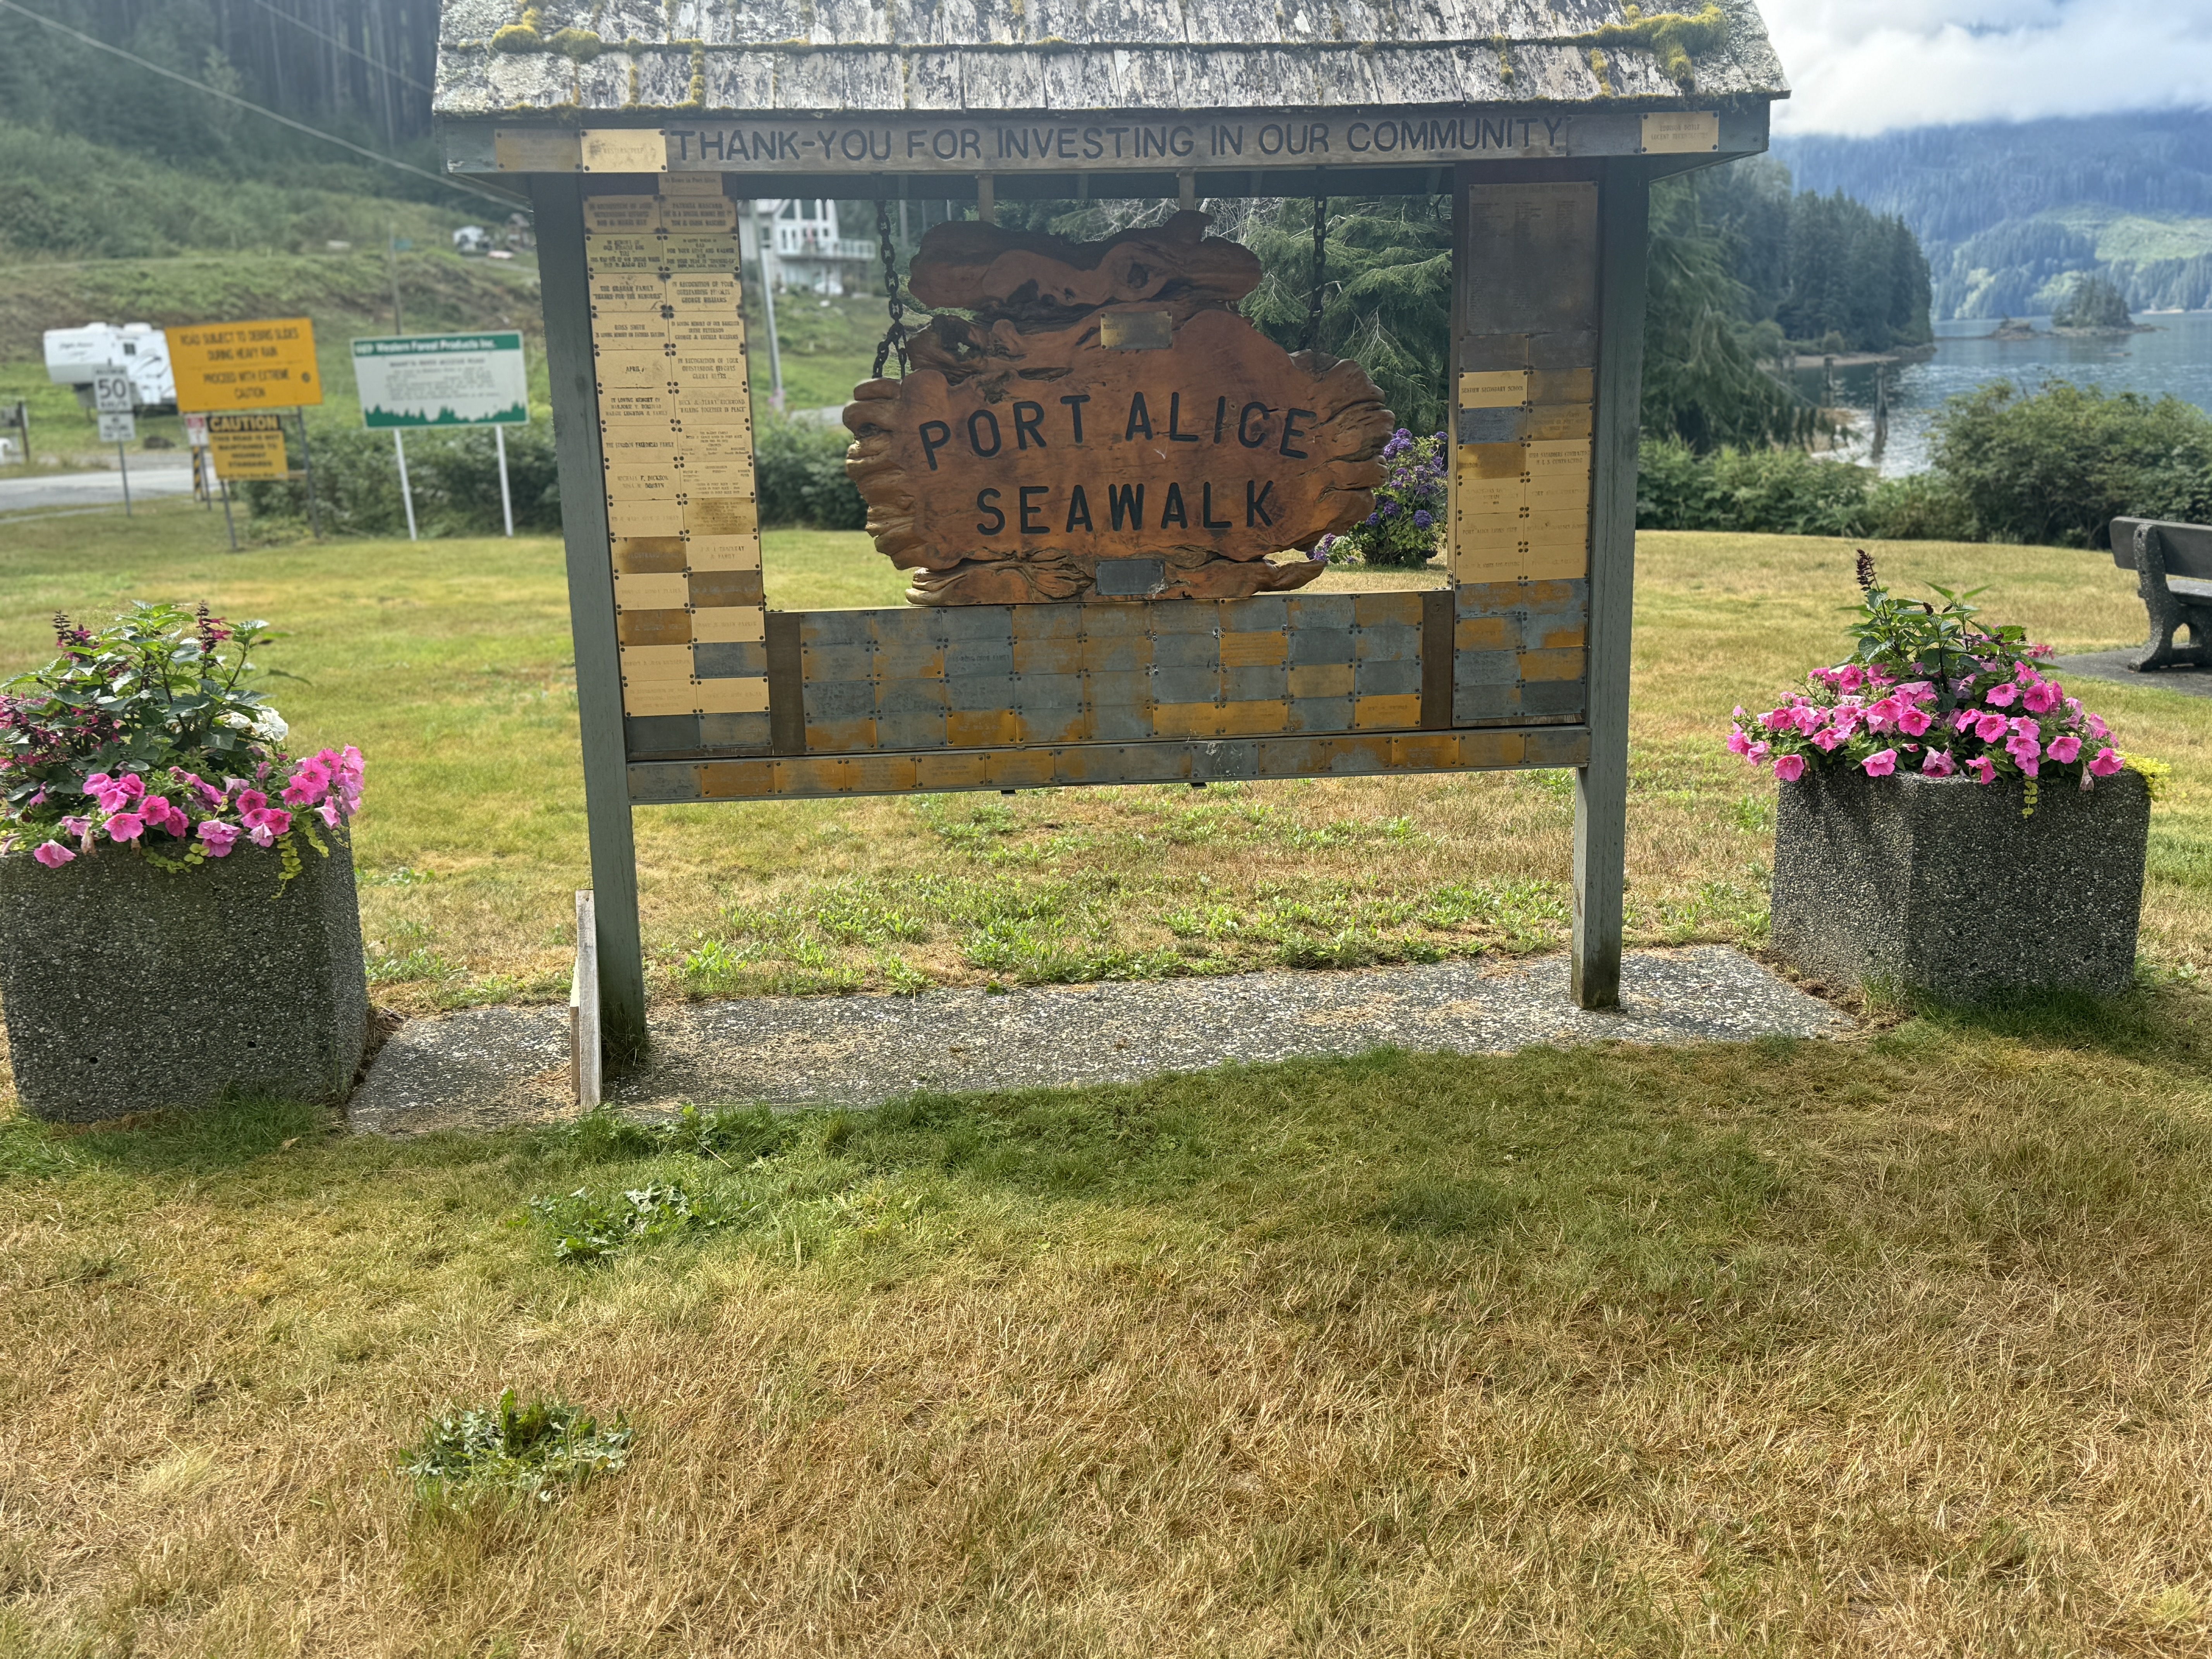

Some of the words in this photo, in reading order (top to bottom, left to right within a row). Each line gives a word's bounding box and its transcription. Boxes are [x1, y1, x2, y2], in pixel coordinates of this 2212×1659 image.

[671, 129, 891, 162] THANK-YOU
[907, 129, 981, 160] FOR
[997, 125, 1194, 159] INVESTING
[1211, 124, 1243, 156] IN
[1259, 122, 1329, 155] OUR
[1346, 117, 1562, 152] COMMUNITY
[203, 331, 234, 344] SUBJECT
[236, 331, 246, 342] TO
[248, 329, 273, 342] DEBRIS
[275, 327, 299, 340] SLIDES
[412, 340, 438, 351] Forest
[440, 338, 478, 349] Products
[207, 348, 234, 361] DURING
[237, 347, 258, 359] HEAVY
[261, 346, 278, 357] RAIN
[203, 372, 237, 385] PROCEED
[239, 371, 256, 382] WITH
[258, 369, 289, 382] EXTREME
[98, 378, 126, 399] 50
[234, 387, 266, 400] CAUTION
[210, 415, 278, 431] CAUTION
[919, 394, 1091, 471] PORT
[1125, 392, 1317, 459] ALICE
[976, 480, 1274, 536] SEAWALK
